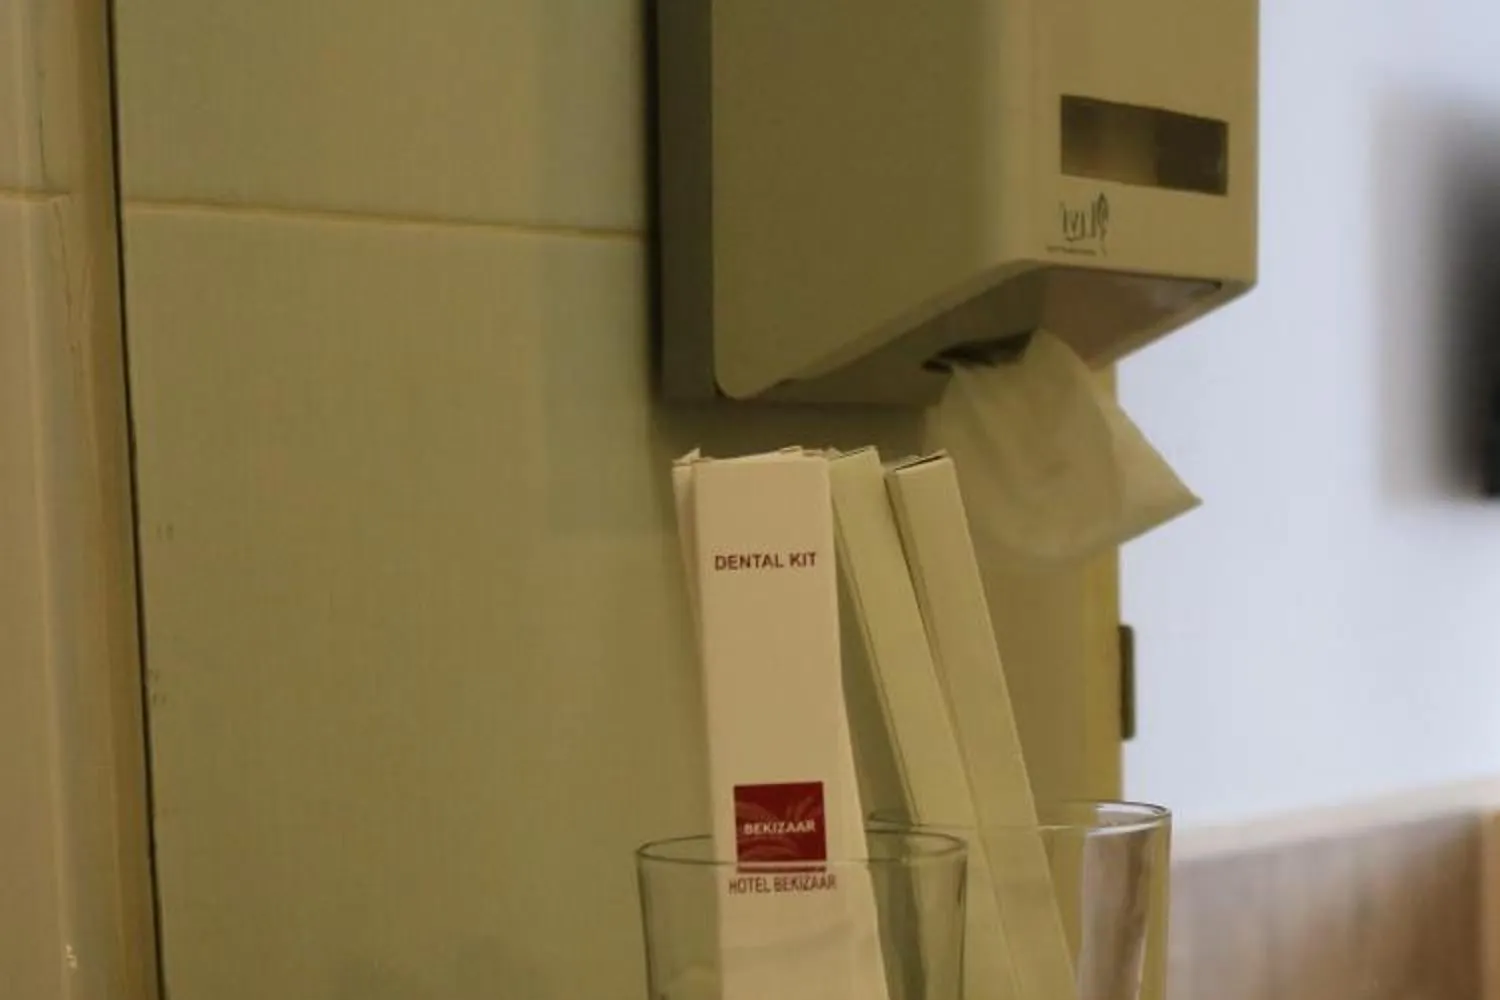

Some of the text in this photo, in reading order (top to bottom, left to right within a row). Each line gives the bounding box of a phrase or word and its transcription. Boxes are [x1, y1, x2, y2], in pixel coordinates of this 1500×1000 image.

[714, 551, 816, 571] DENTAL KIT
[743, 819, 815, 835] BEKIZAAR
[728, 874, 836, 894] HOTEL BEKIZAAR
